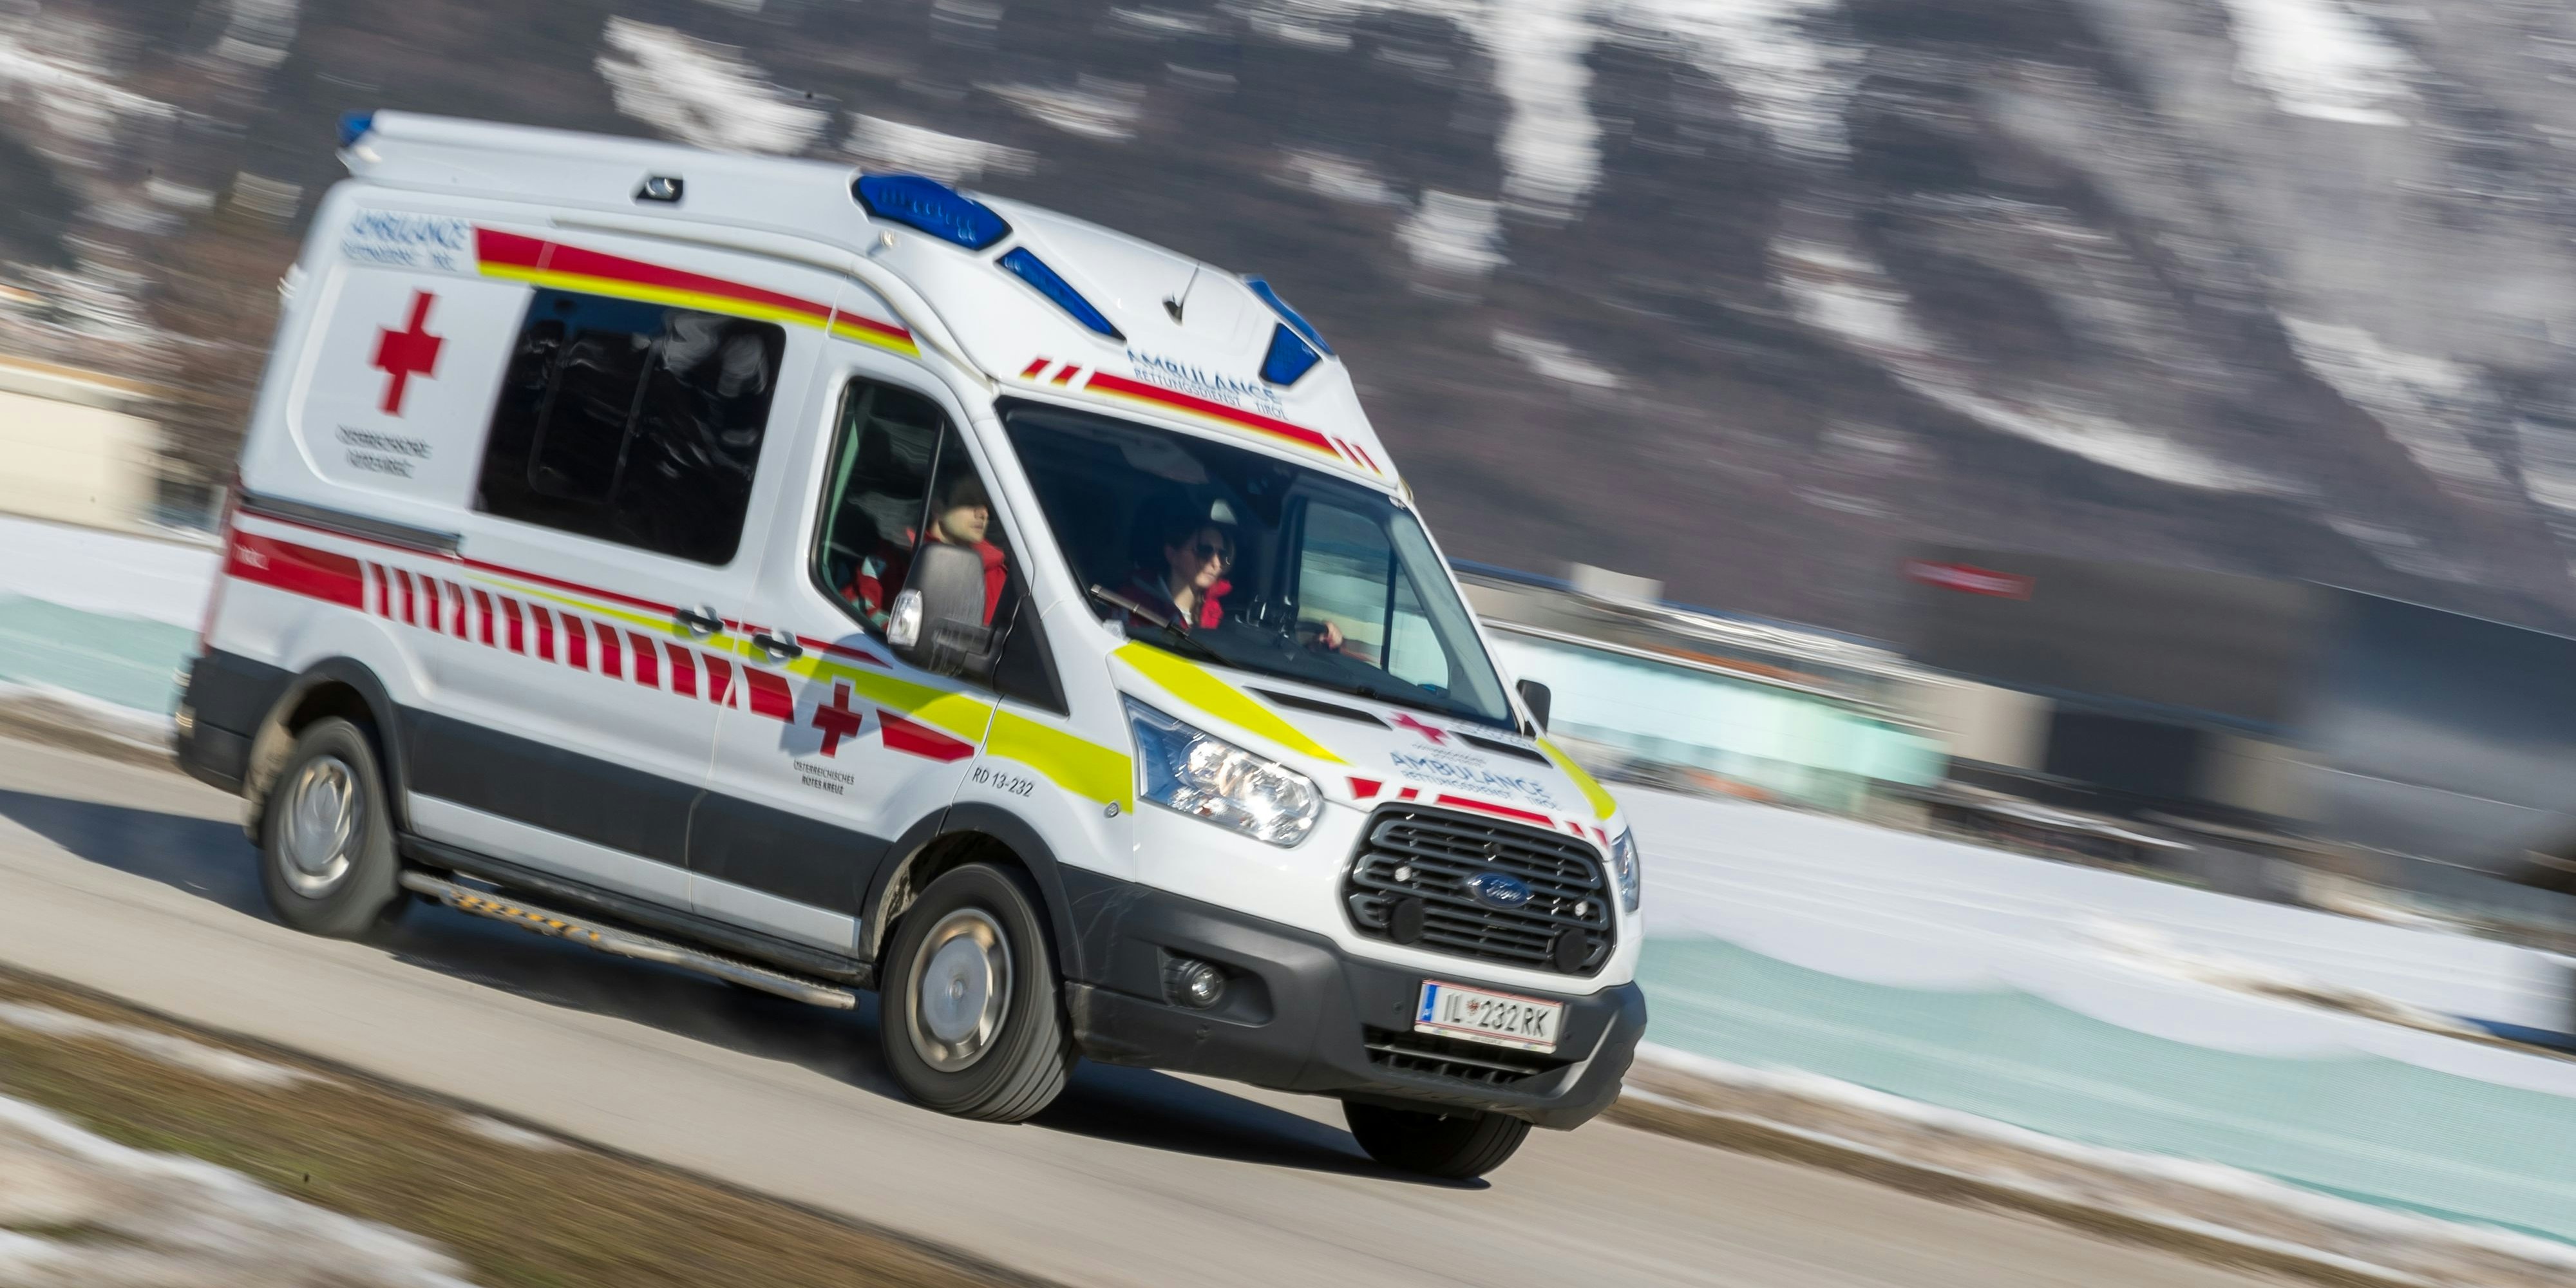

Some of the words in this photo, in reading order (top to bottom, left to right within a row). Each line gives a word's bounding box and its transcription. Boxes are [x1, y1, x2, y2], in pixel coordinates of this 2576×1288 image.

[1127, 346, 1282, 406] AMBULANCE
[1133, 368, 1242, 407] RETTUNGSDIENST
[1255, 401, 1289, 421] TIROL
[801, 775, 822, 790] ROTES
[822, 780, 844, 795] KREUZ
[972, 767, 990, 784] RD
[992, 772, 1034, 797] 13-232
[1390, 752, 1550, 799] AMBULANCE
[1443, 992, 1461, 1023] IL
